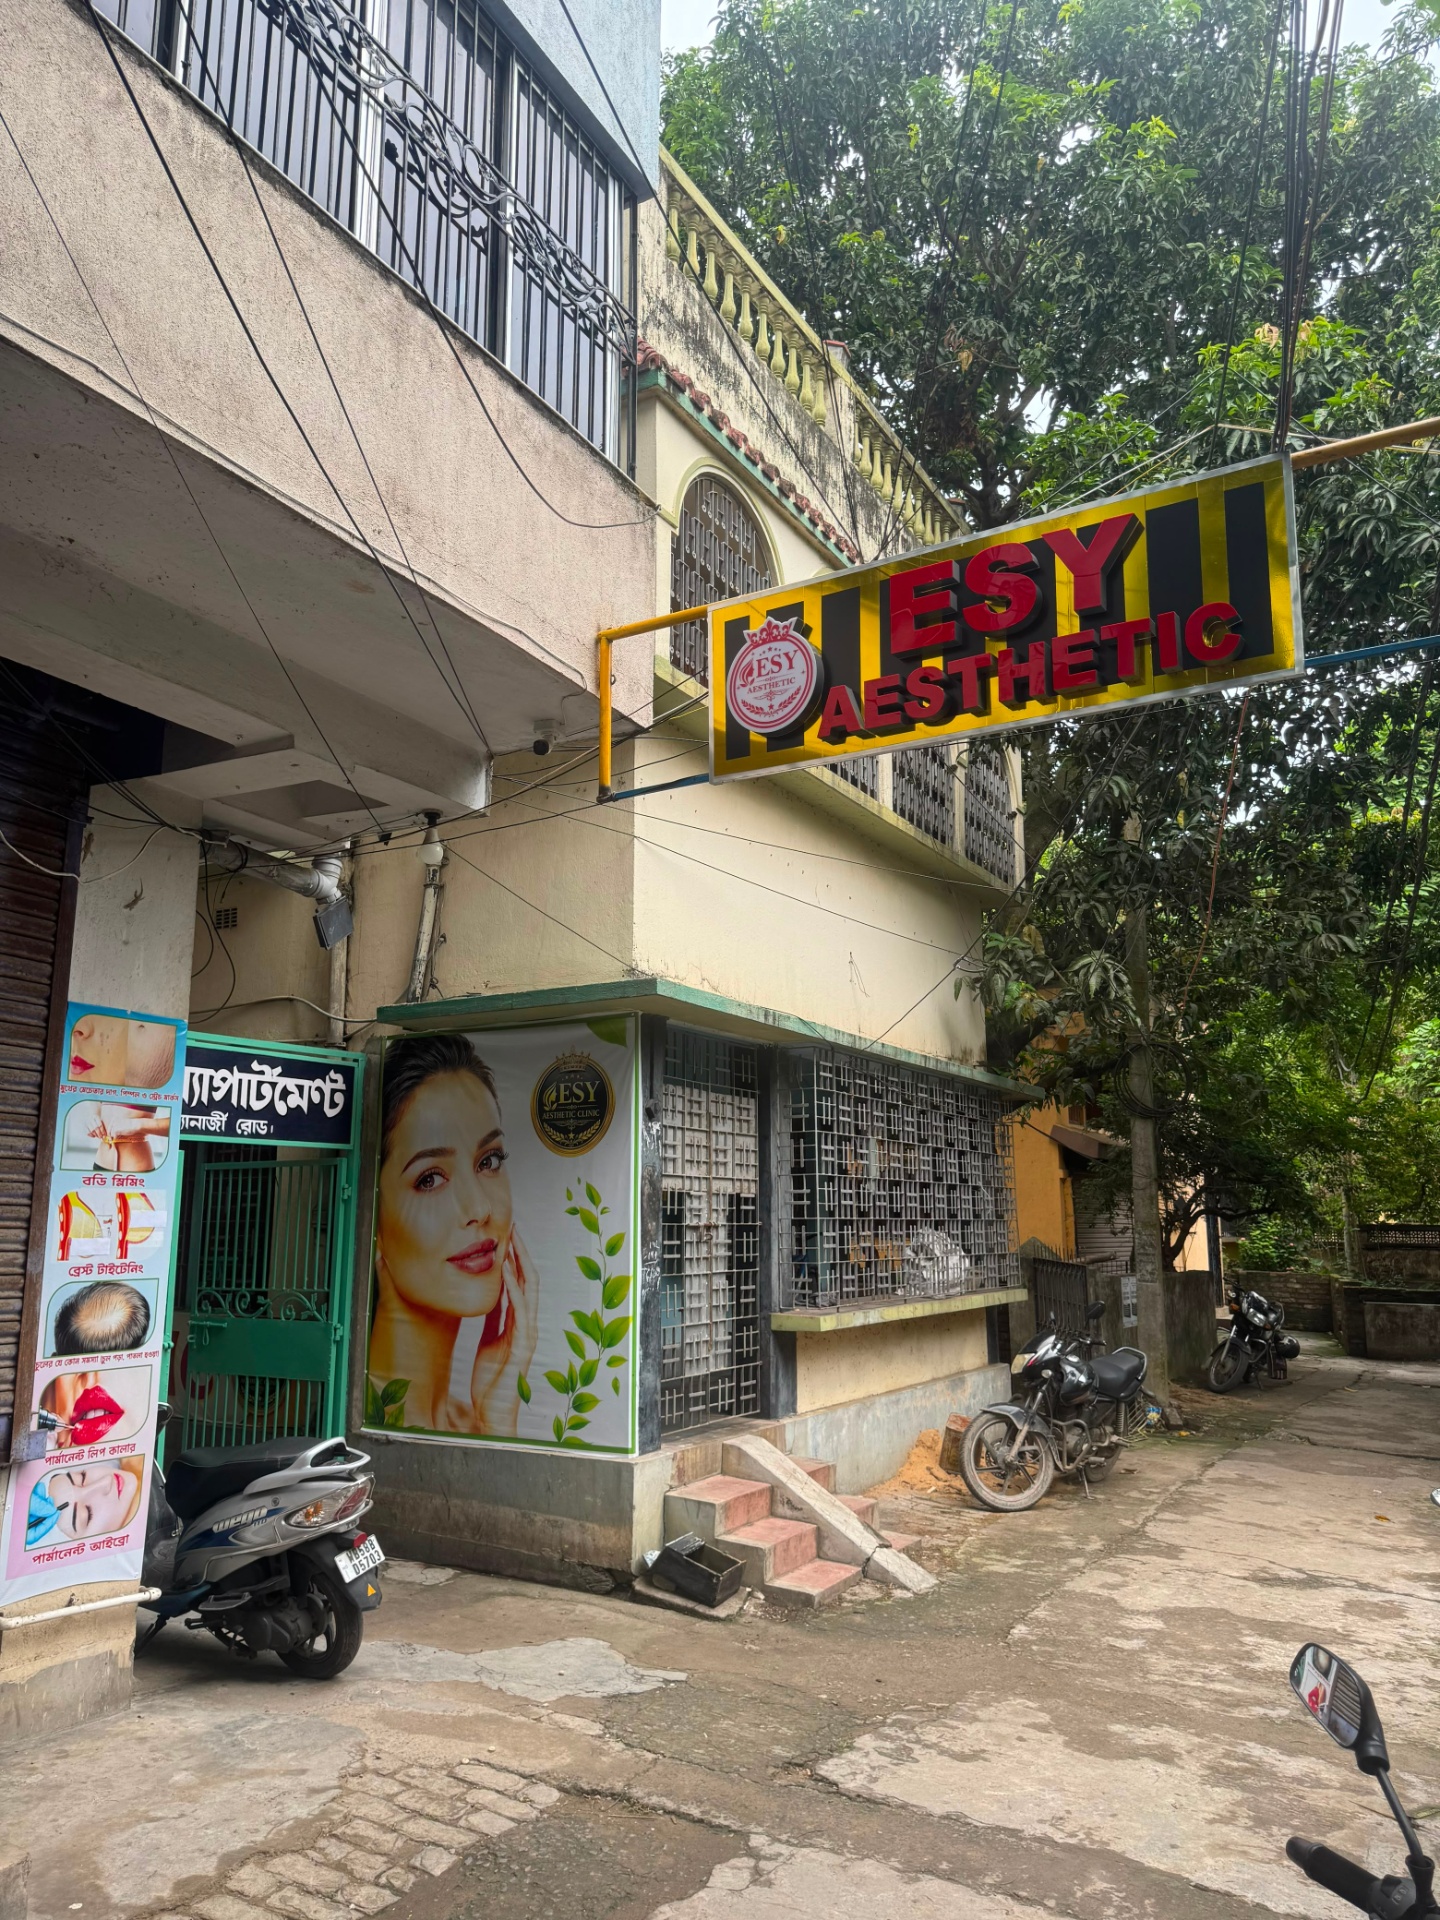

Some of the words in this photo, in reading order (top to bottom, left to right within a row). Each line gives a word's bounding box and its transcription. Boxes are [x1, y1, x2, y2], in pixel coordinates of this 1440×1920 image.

[889, 512, 1143, 657] ESY
[756, 649, 798, 678] ESY
[817, 601, 1243, 744] AESTHETIC
[747, 676, 796, 694] AESTHETIC
[59, 1084, 77, 1095] মুখের
[559, 1081, 601, 1103] ESY
[543, 1111, 576, 1120] AESTHETIC
[578, 1110, 600, 1118] CLINIC
[82, 1173, 107, 1186] বডি
[68, 1263, 94, 1277] ব্রেস্ট
[97, 1261, 144, 1275] টাইটেনিং
[34, 1360, 53, 1372] চুলের
[45, 1449, 85, 1466] পার্মানেন্ট
[87, 1446, 106, 1459] লিপ
[108, 1443, 136, 1456] কালার
[32, 1542, 86, 1564] পার্মানেন্ট
[89, 1534, 130, 1552] আইব্রো
[352, 1549, 382, 1576] D5703
